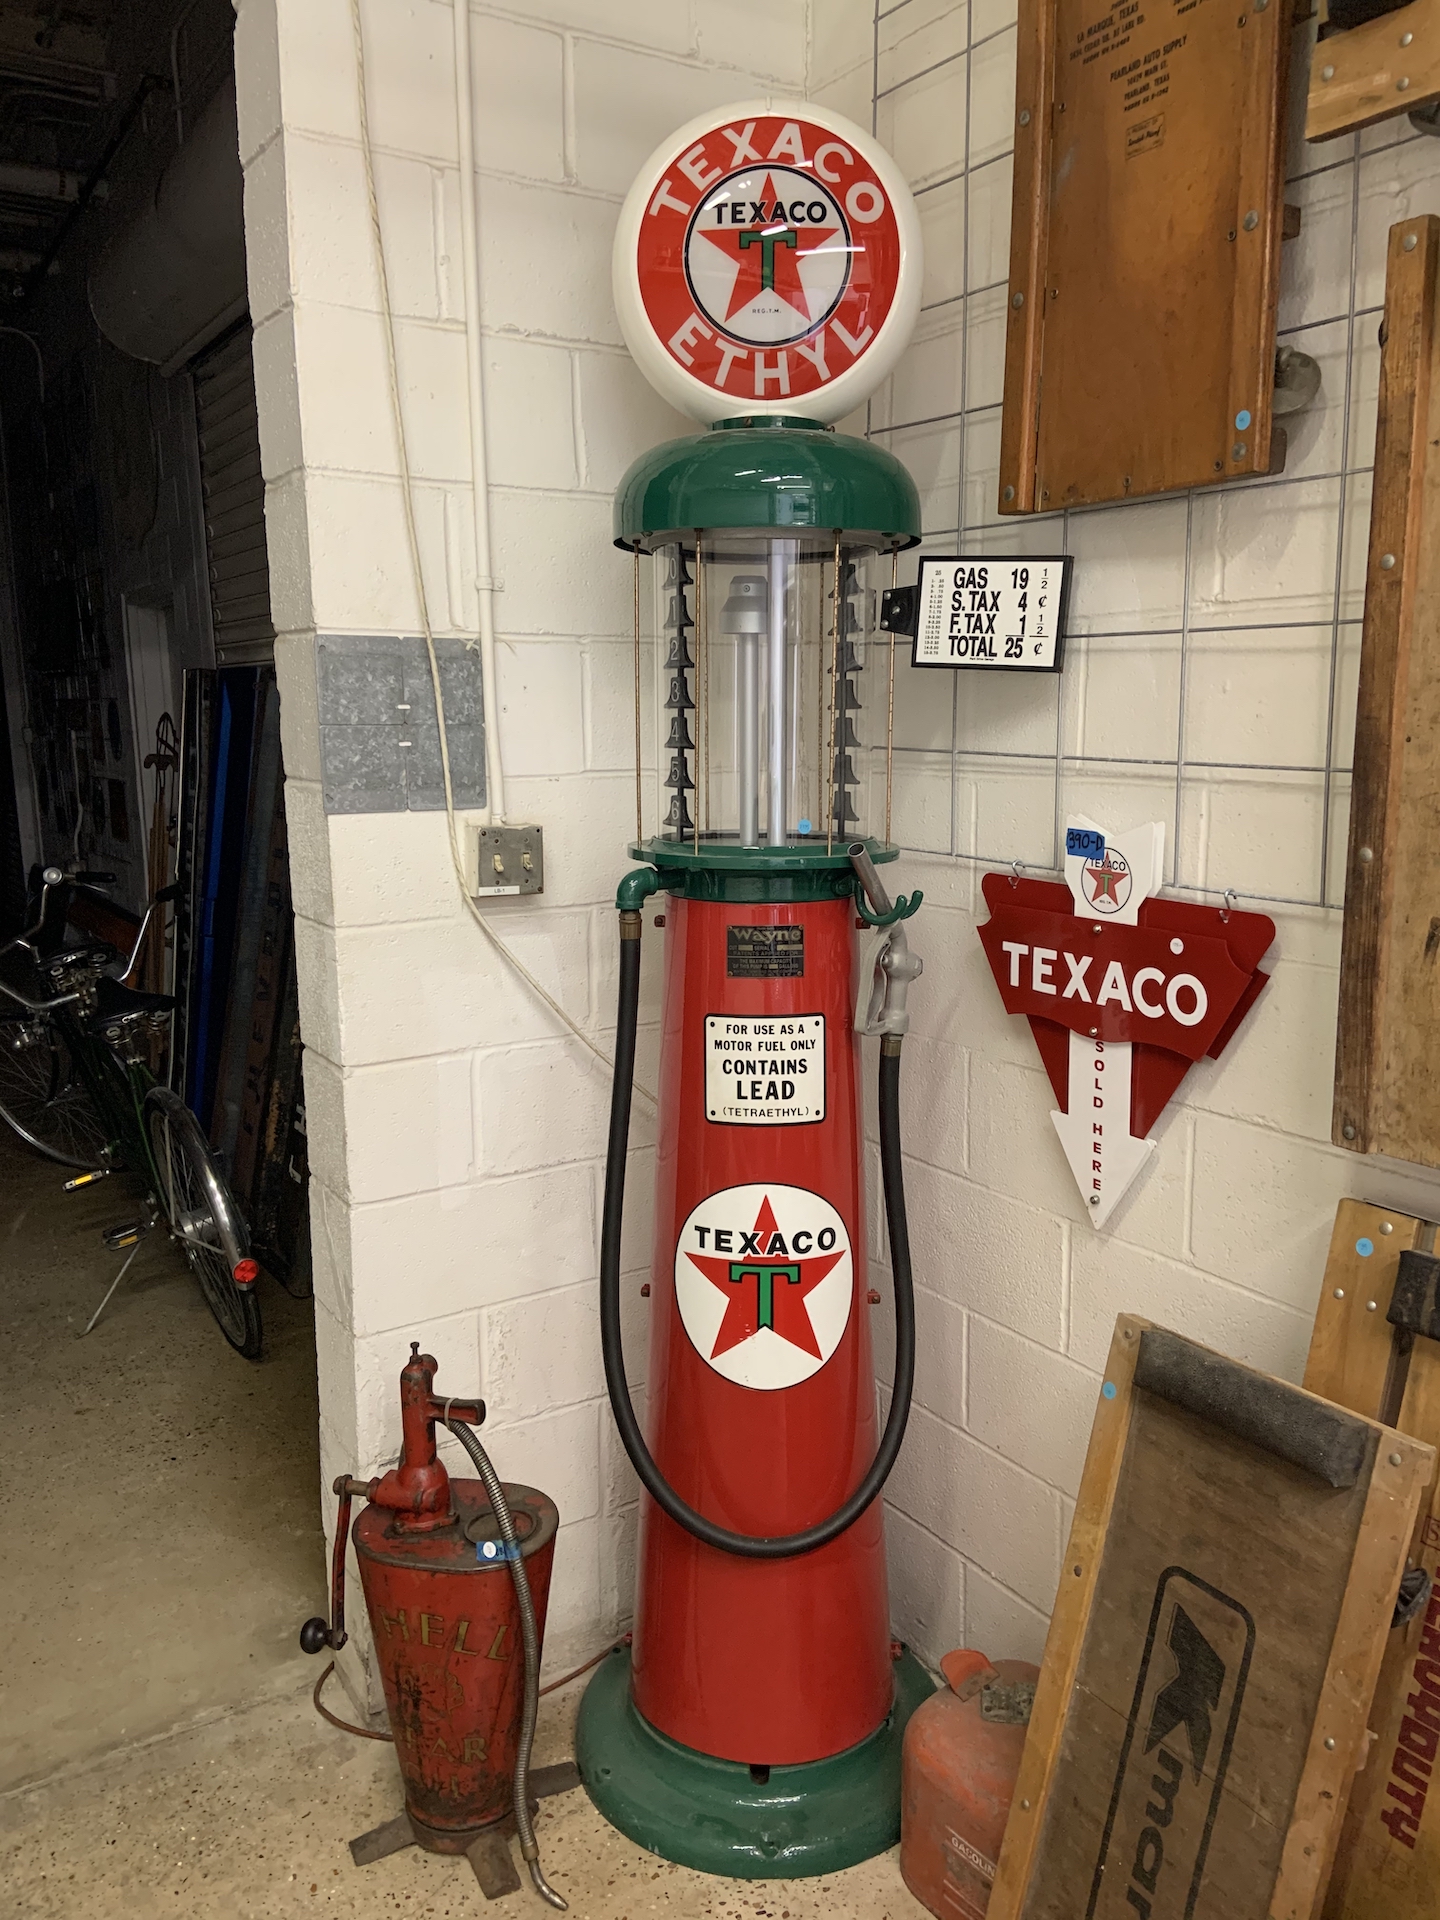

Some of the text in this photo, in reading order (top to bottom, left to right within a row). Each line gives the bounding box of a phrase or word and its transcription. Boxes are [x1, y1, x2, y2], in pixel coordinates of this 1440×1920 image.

[1110, 33, 1188, 82] PEARLAND AUTO SUPPLY
[649, 122, 885, 224] TEXACO
[713, 201, 828, 224] TEXACO
[739, 230, 797, 291] T
[667, 312, 874, 396] ETHYL
[670, 557, 677, 580] 0
[953, 567, 989, 589] GAS
[1011, 568, 1029, 590] 19
[1018, 592, 1028, 612] 4
[1019, 615, 1026, 635] 1
[670, 640, 679, 660] 2
[948, 635, 998, 658] TOTAL
[1004, 637, 1024, 659] 25
[671, 681, 680, 702] 3
[671, 721, 680, 742] 4
[671, 761, 680, 781] 5
[671, 801, 680, 820] 6
[1067, 831, 1104, 852] 390-D
[1089, 857, 1126, 871] TEXACO
[732, 927, 802, 944] Wayne
[1001, 941, 1209, 1027] TEXACO
[726, 1024, 805, 1035] FOR USE AS A
[714, 1039, 816, 1052] MOTOR FUEL ONLY
[722, 1058, 808, 1075] CONTAINS
[1093, 1041, 1105, 1109] SOLD
[736, 1080, 796, 1100] LEAD
[722, 1106, 809, 1118] (TETRAETHYL)
[1092, 1122, 1103, 1191] HERE
[694, 1225, 837, 1255] TEXACO
[729, 1262, 801, 1332] T
[377, 1605, 511, 1662] HELL
[1380, 1566, 1440, 1850] AVYDUTY
[1126, 1602, 1226, 1920] Kmar
[951, 1836, 997, 1877] GASOLIN
